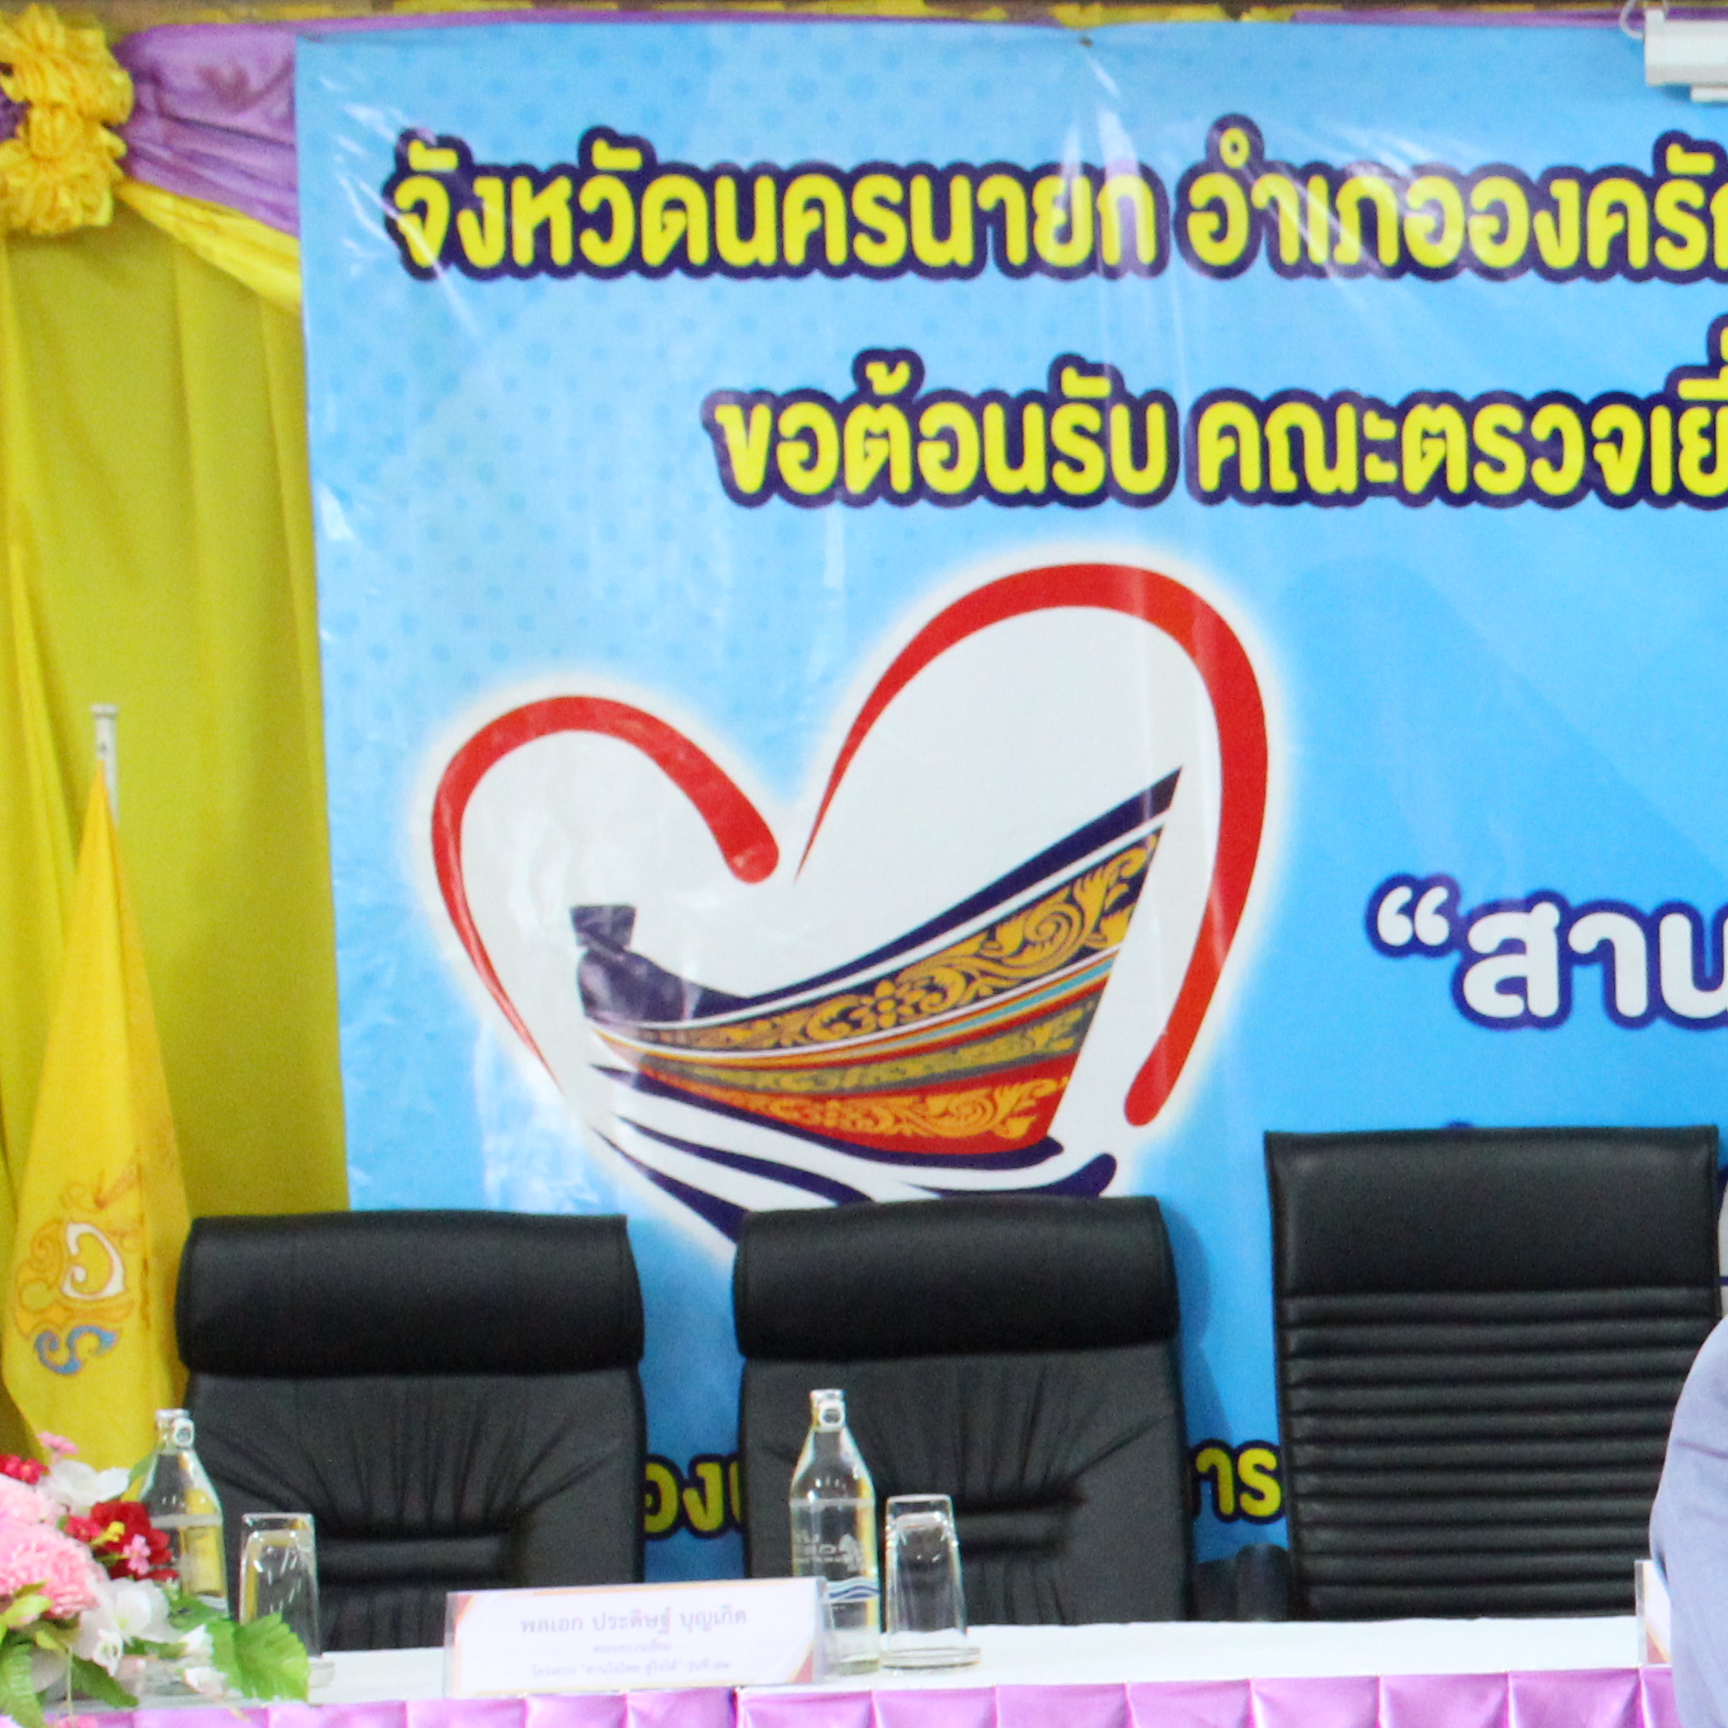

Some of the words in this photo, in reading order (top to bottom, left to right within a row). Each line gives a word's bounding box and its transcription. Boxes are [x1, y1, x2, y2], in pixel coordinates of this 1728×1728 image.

[393, 137, 1160, 269] จังหวัดนครนายก
[713, 359, 1170, 496] ขอต้อนรับ
[519, 1615, 583, 1634] พลเอก
